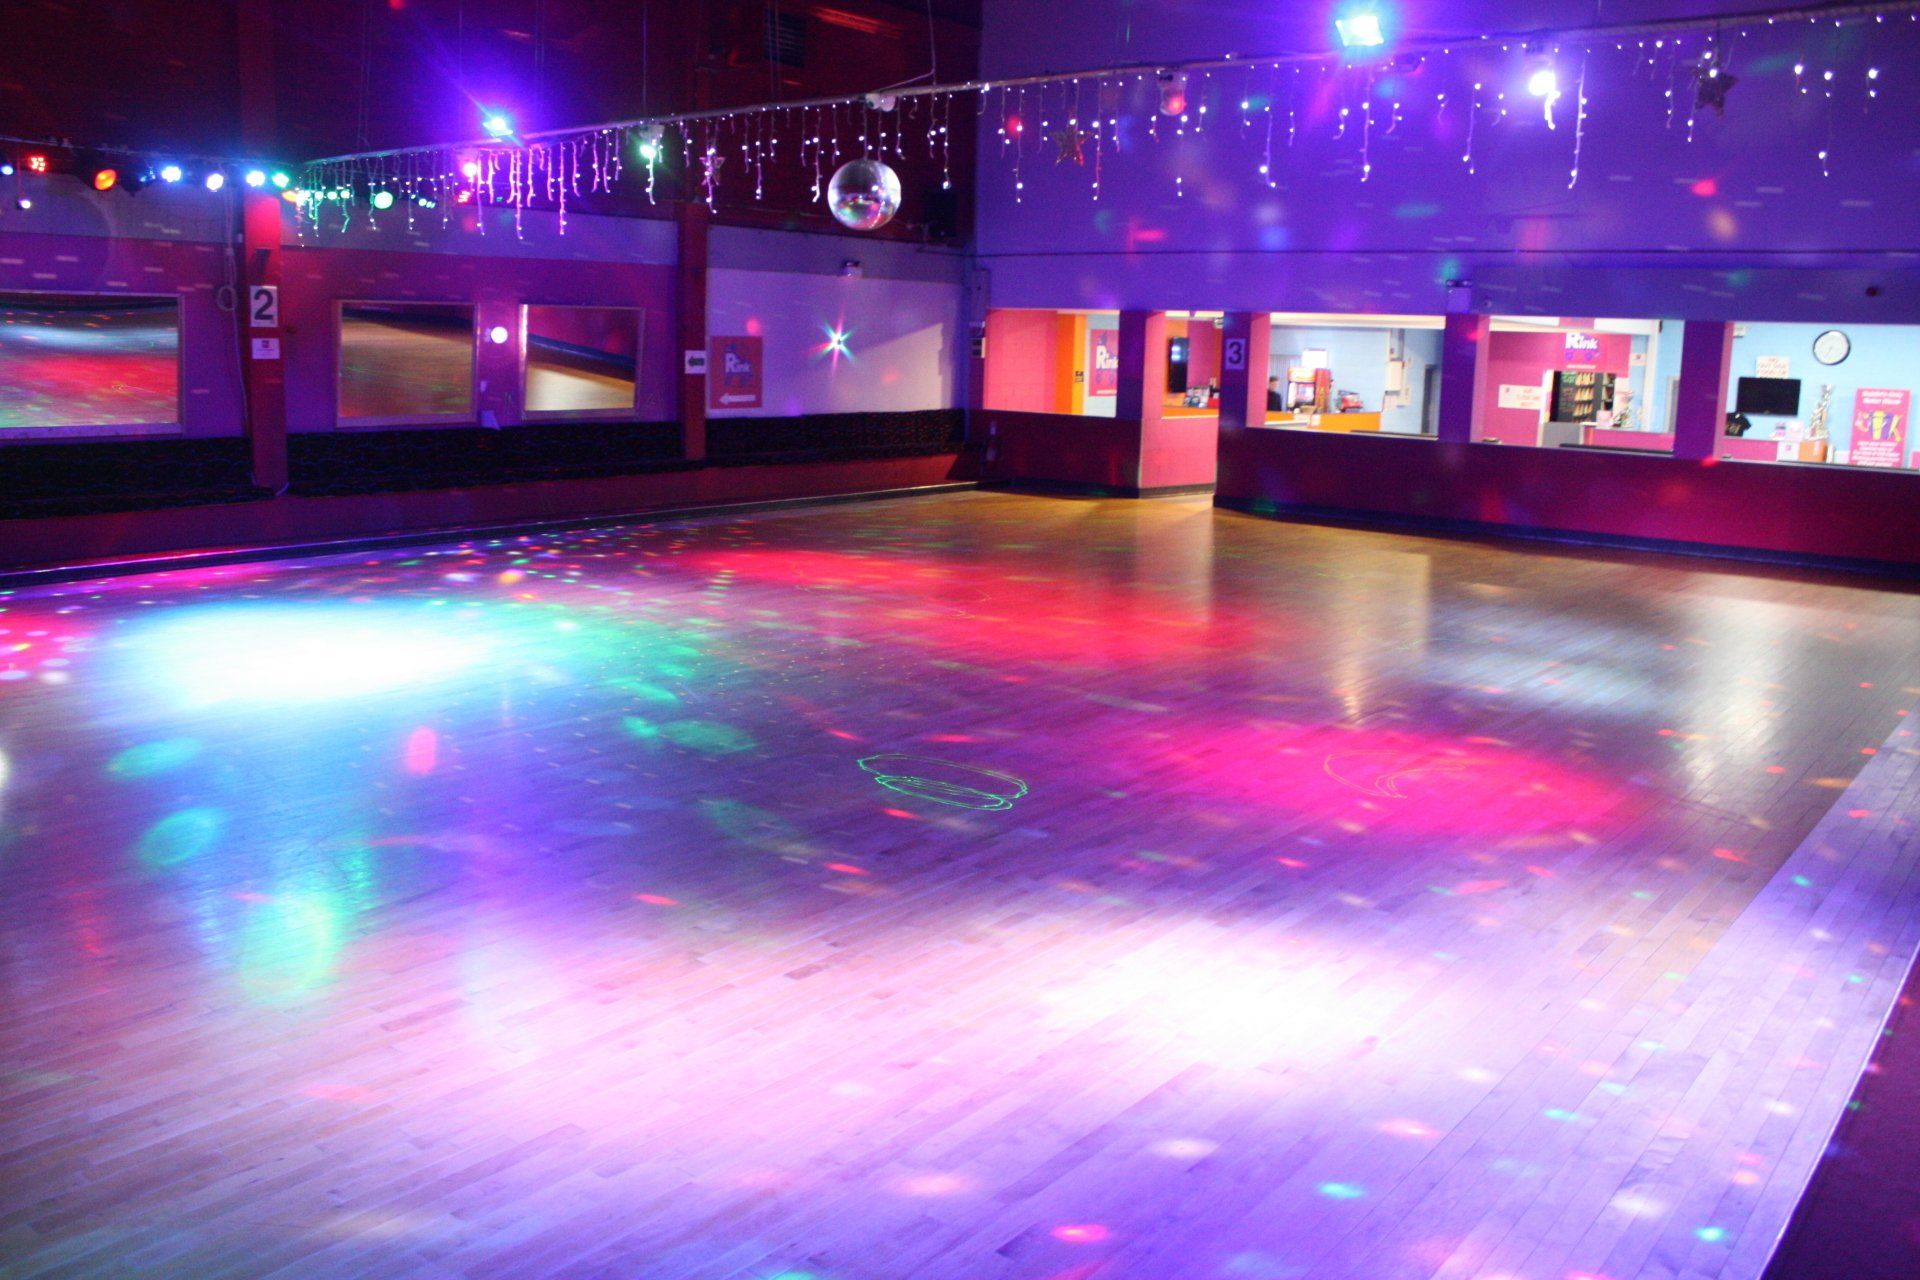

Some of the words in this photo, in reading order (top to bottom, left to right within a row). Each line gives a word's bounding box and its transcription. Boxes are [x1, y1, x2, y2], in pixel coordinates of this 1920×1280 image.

[254, 289, 274, 320] 2
[1565, 332, 1598, 349] Rink
[1228, 342, 1243, 364] 3
